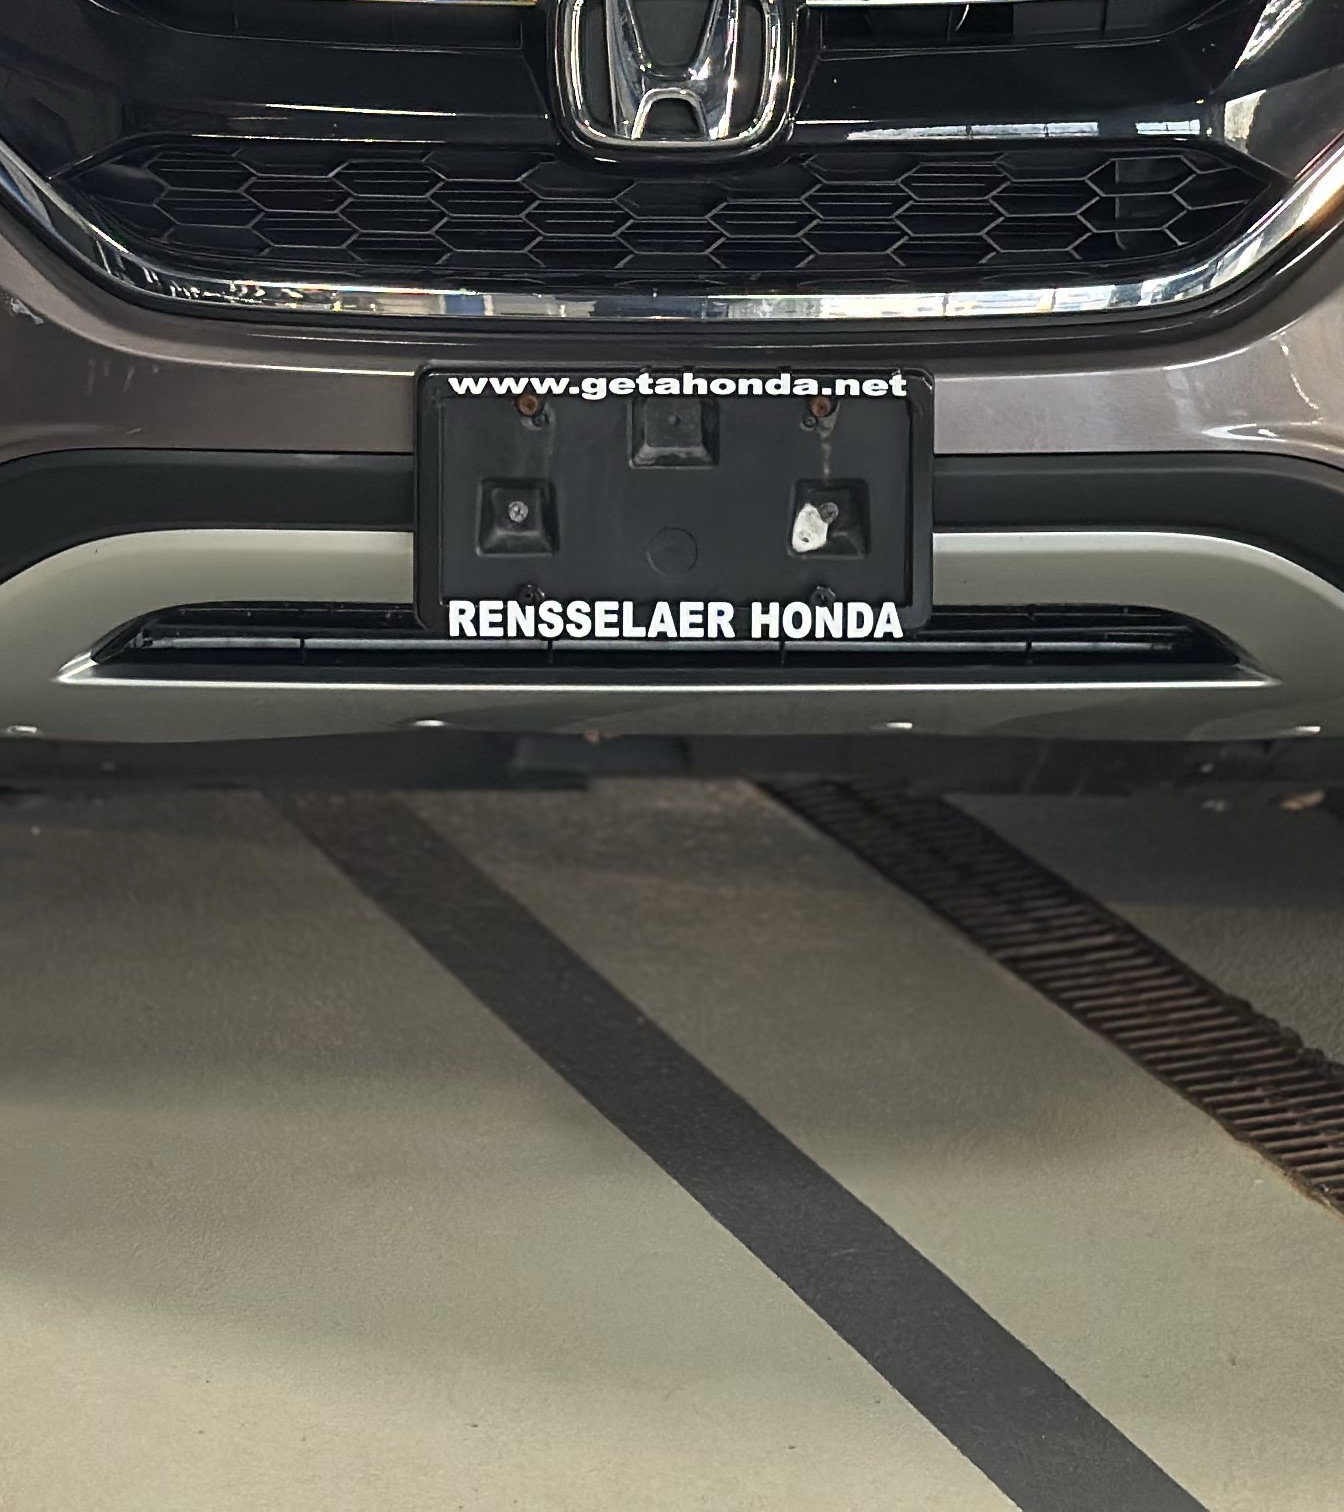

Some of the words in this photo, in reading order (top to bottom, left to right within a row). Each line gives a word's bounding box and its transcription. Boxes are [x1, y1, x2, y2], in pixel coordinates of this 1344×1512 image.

[448, 373, 907, 399] www.getahonda.net
[448, 600, 736, 638] RENSSELAER
[751, 601, 904, 639] HONDA
